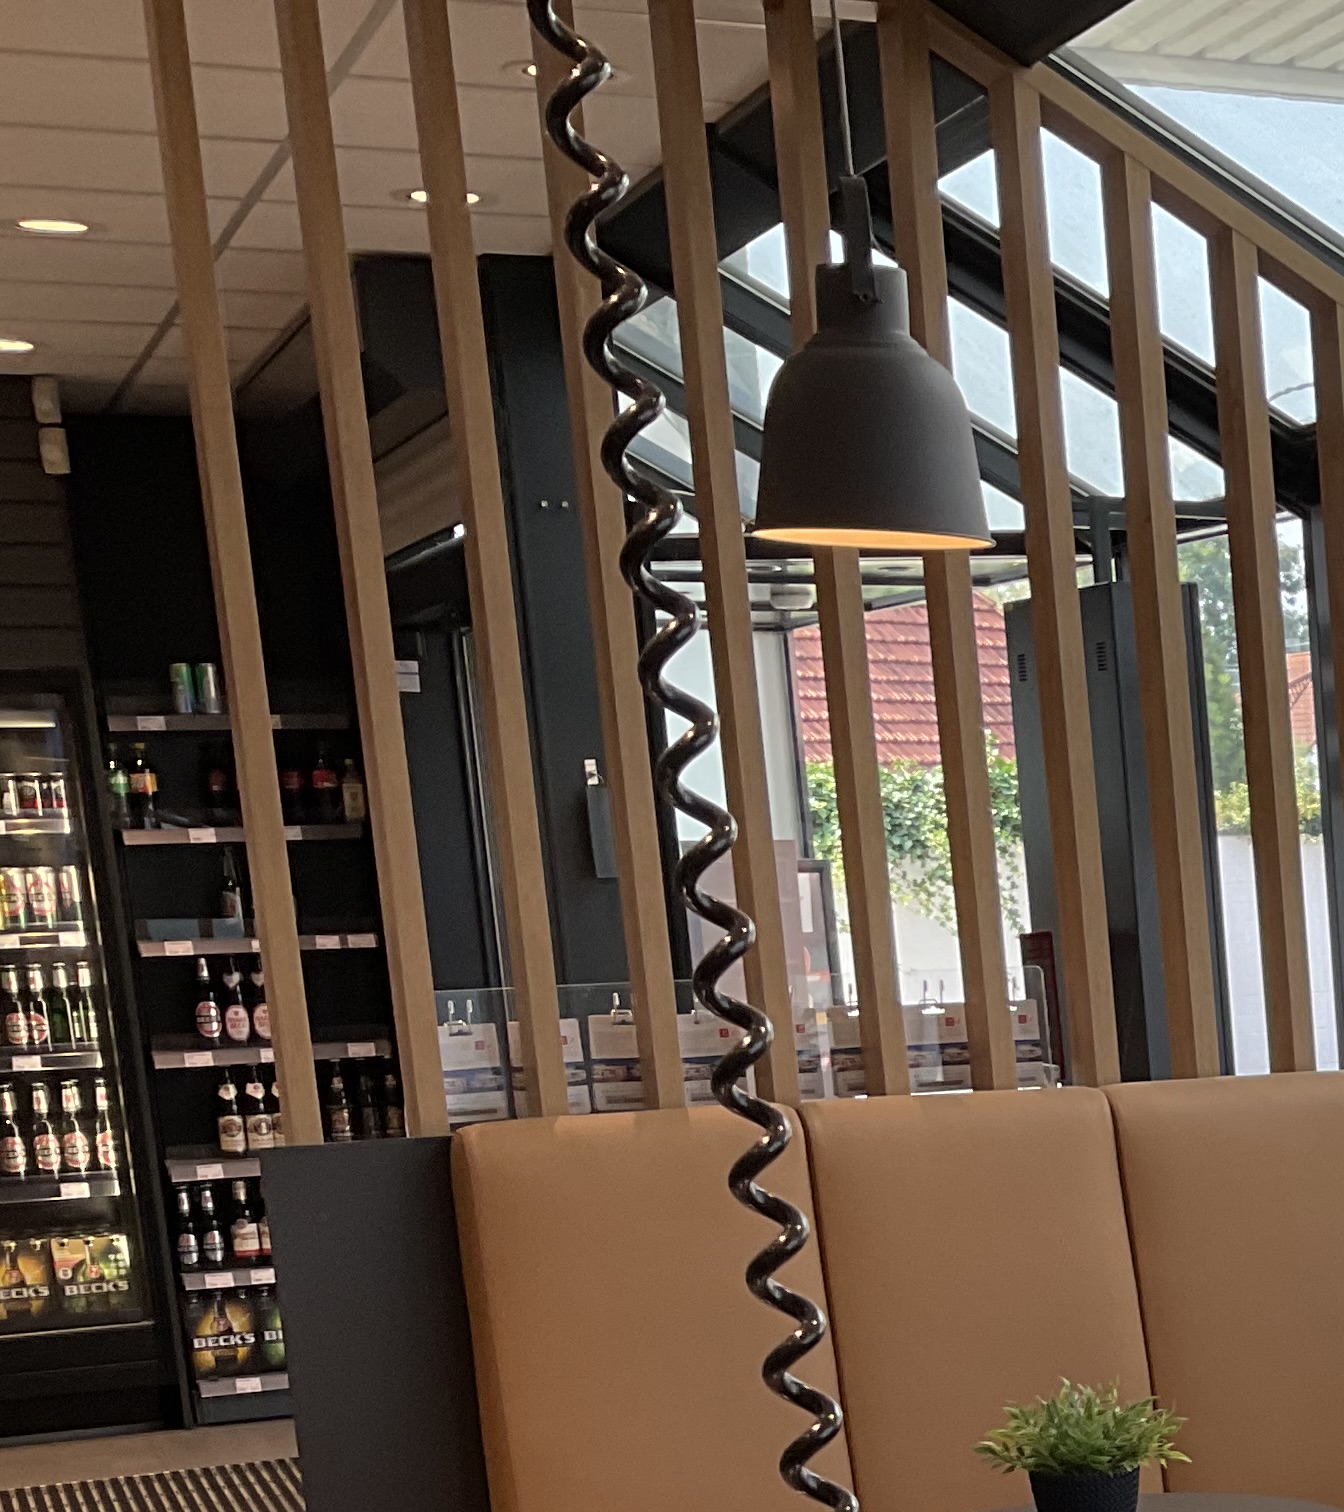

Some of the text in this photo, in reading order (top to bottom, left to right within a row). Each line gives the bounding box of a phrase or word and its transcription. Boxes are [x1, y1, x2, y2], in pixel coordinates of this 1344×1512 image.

[0, 1284, 50, 1299] ECK'S
[64, 1280, 130, 1297] BECK'S
[192, 1331, 256, 1349] BECK'S
